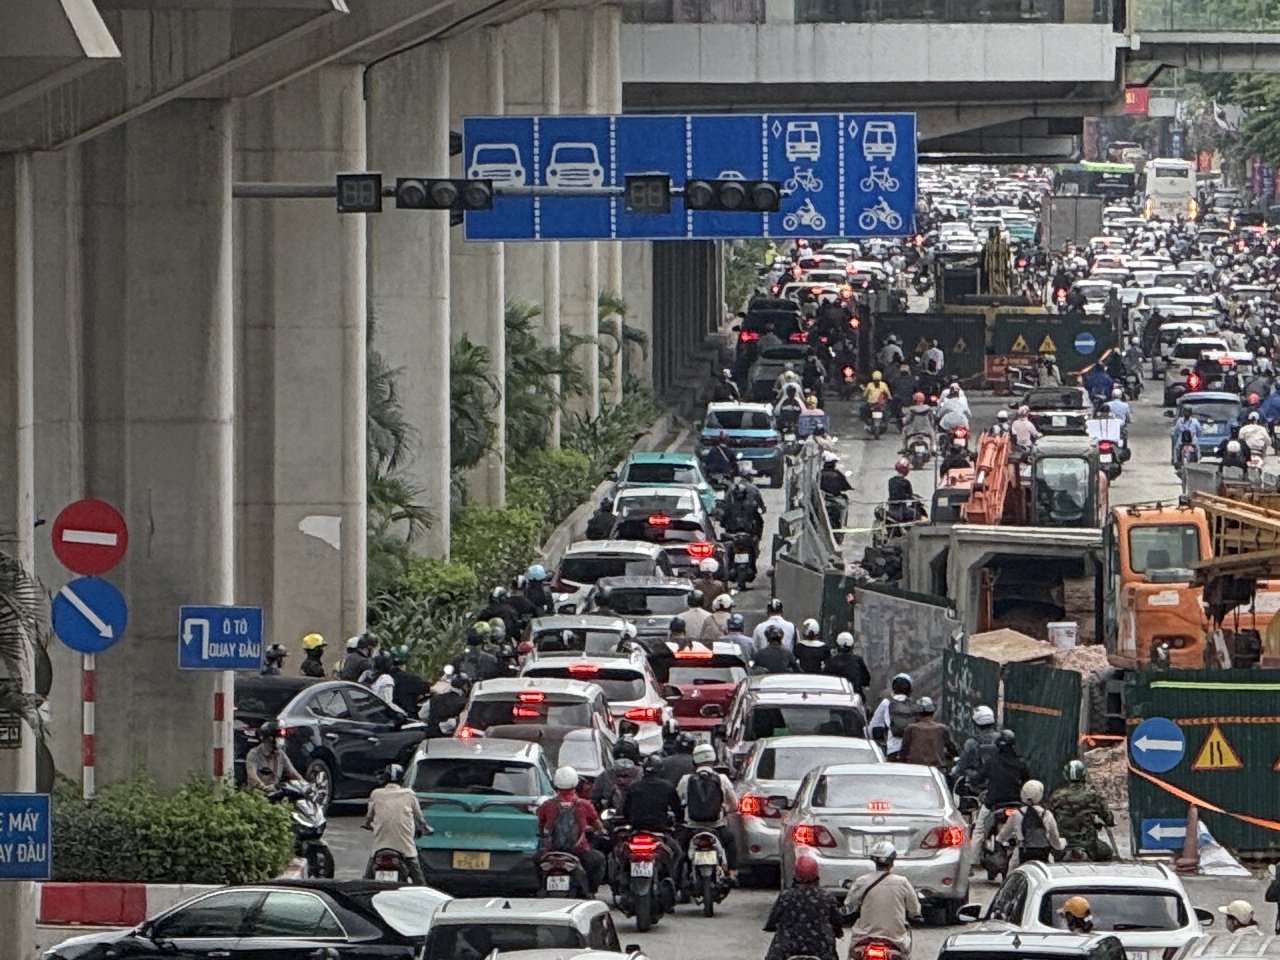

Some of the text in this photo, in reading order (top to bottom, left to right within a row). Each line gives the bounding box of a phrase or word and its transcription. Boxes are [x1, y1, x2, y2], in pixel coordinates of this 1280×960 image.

[233, 616, 248, 635] TÔ
[209, 638, 261, 658] QUAY ĐẦU
[9, 807, 40, 832] MÁY
[18, 835, 47, 863] ĐẦU
